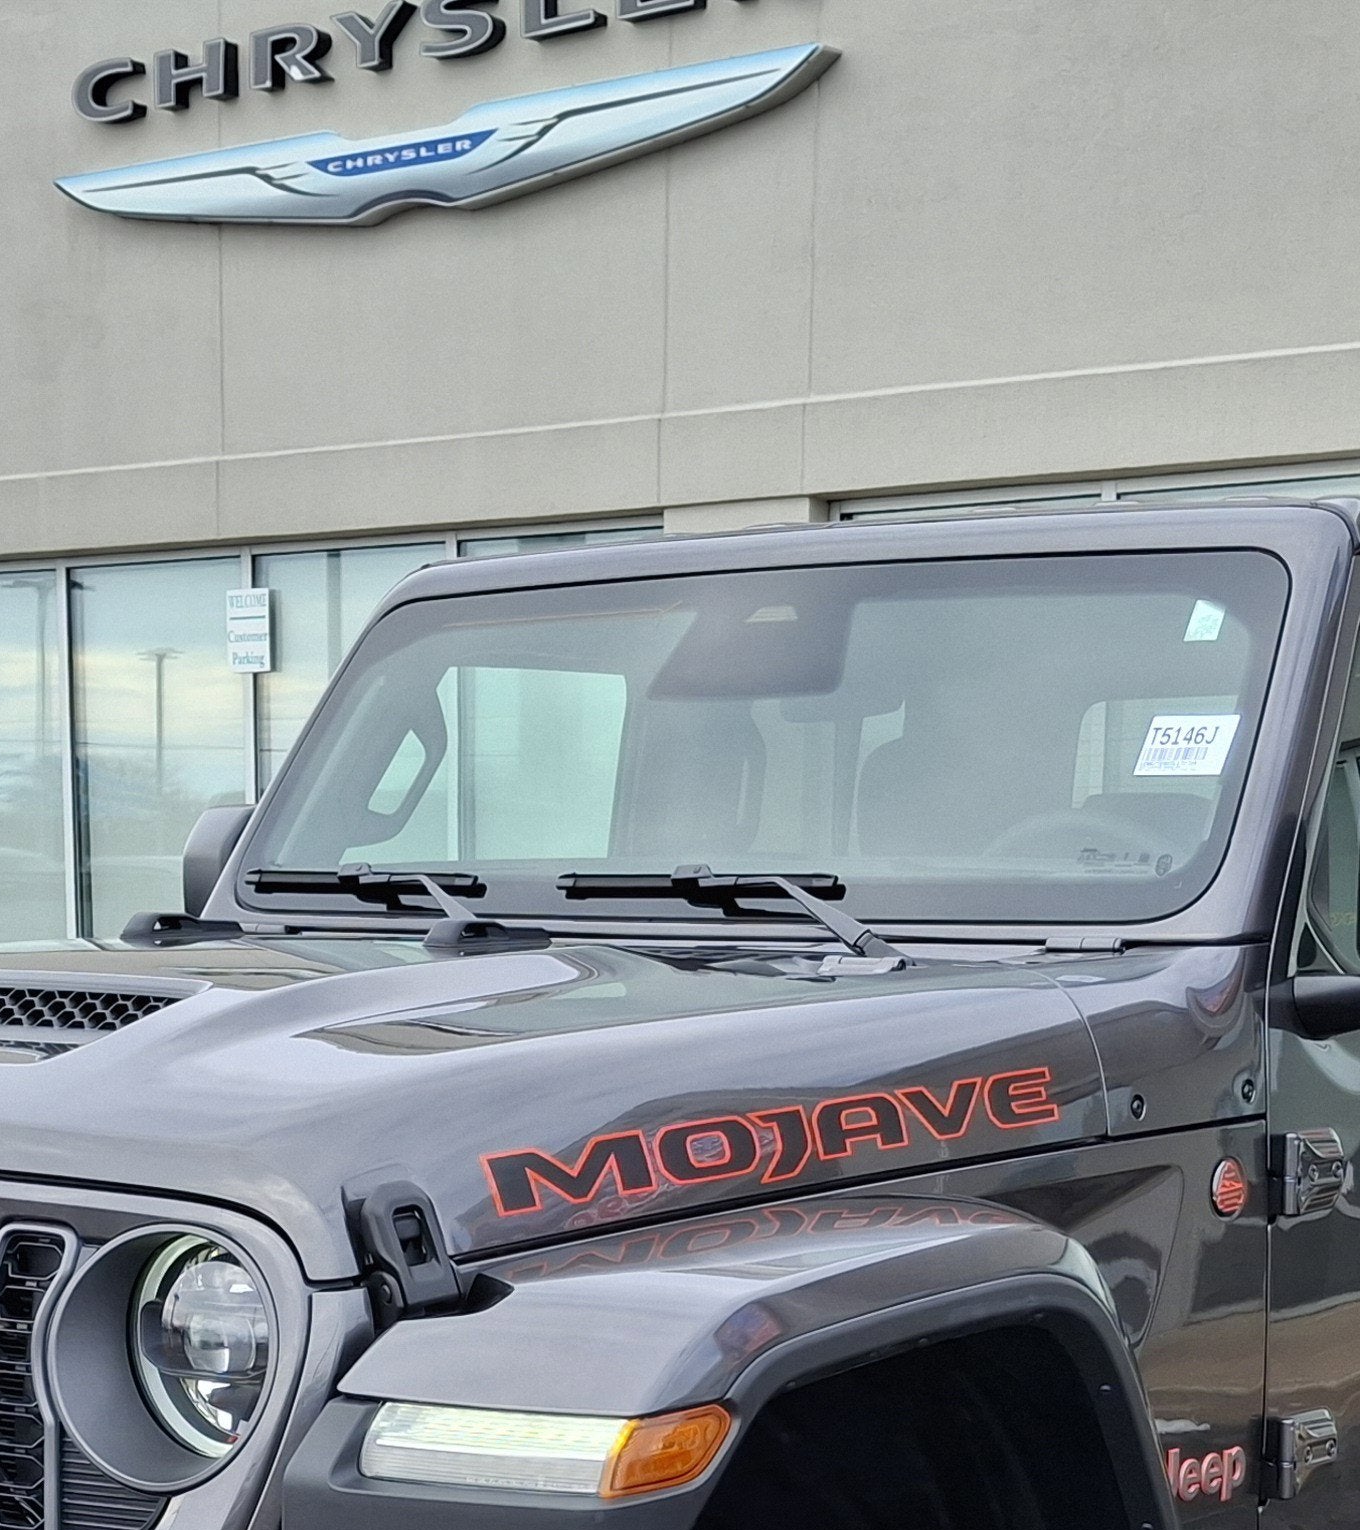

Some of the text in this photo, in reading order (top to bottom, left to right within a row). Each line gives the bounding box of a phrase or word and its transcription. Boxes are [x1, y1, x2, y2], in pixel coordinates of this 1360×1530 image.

[72, 0, 725, 123] CHRYSL
[326, 139, 473, 173] CHRYSLER
[227, 594, 267, 609] WELCOME
[228, 631, 267, 643] Customer
[232, 652, 265, 668] Parking
[1150, 726, 1220, 746] T5146J
[479, 1067, 1059, 1216] MOJAVE
[1167, 1446, 1246, 1501] Jeep
